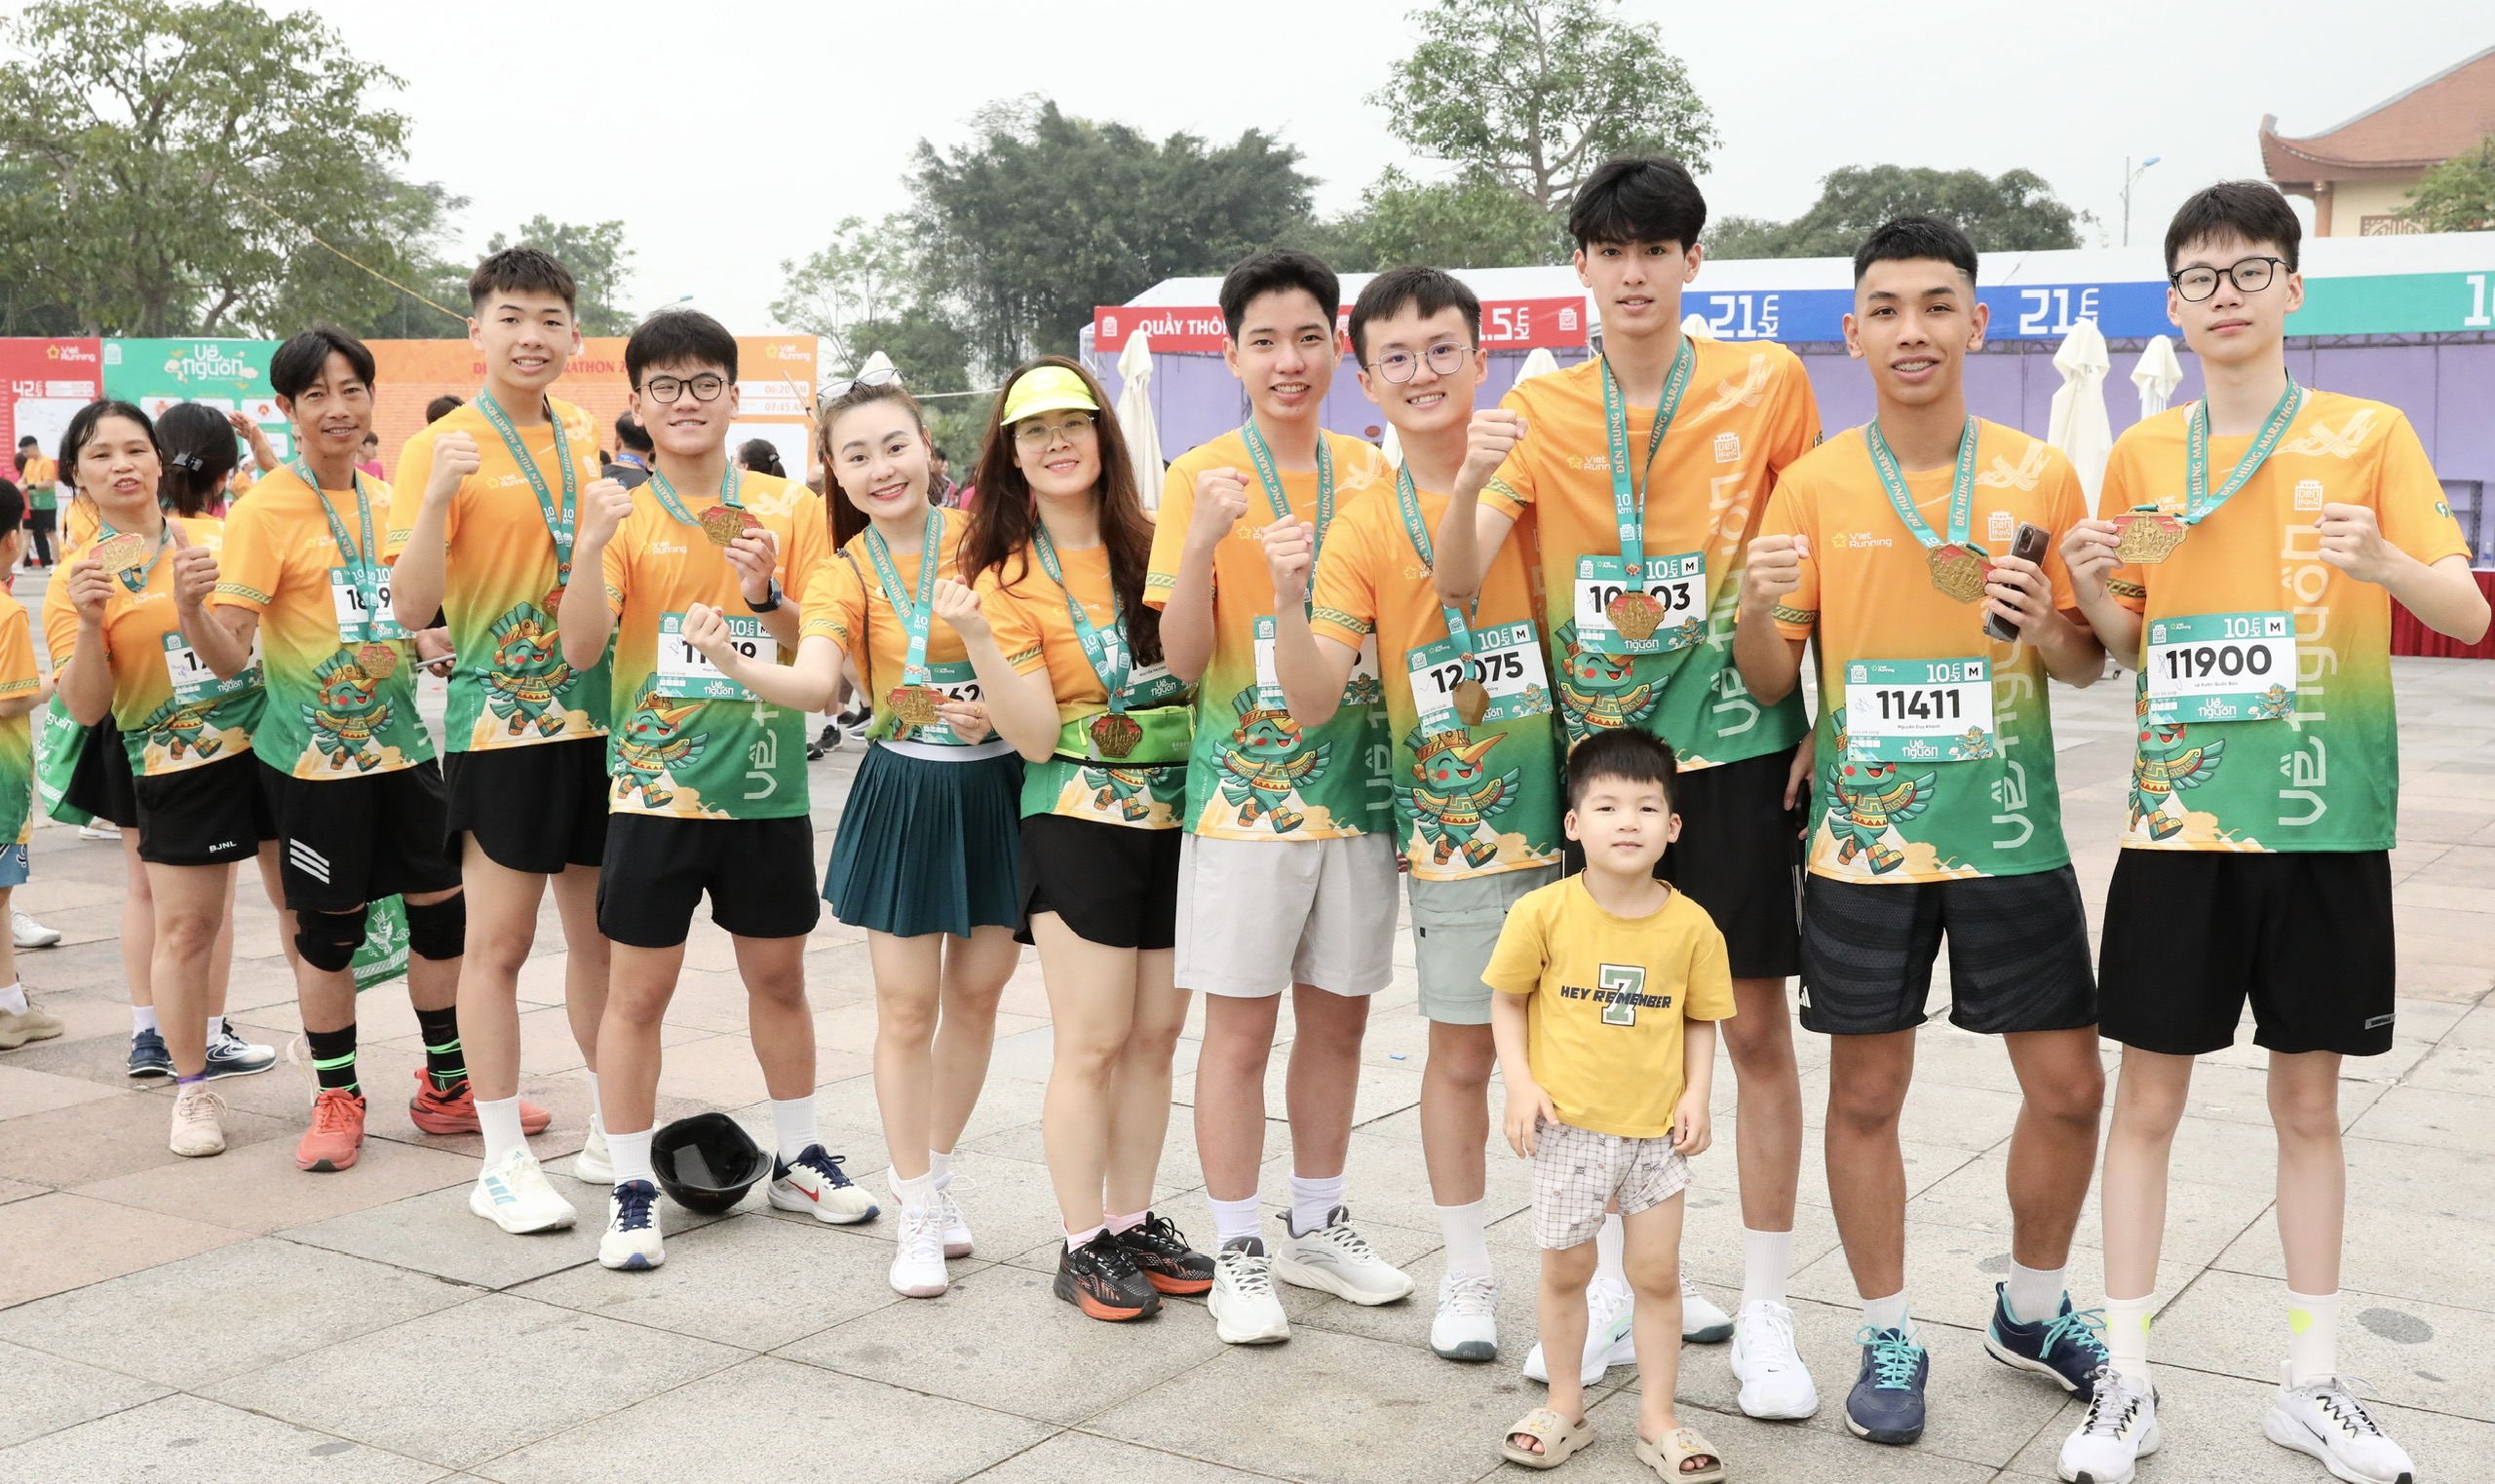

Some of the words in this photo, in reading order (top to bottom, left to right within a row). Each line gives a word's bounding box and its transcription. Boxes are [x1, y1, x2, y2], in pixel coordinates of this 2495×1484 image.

[2464, 274, 2495, 326] 1
[1709, 295, 1757, 338] 21
[2019, 288, 2073, 335] 21
[1138, 312, 1183, 338] QUẦY
[1187, 316, 1228, 335] THÔ
[1478, 308, 1513, 341] .5
[181, 358, 244, 381] nguồn
[563, 362, 615, 374] RATHON
[13, 380, 35, 397] 42
[765, 385, 790, 394] 06:20
[1665, 351, 1690, 415] MARATHON
[765, 402, 789, 411] 07:45
[2258, 395, 2298, 450] MARATHON
[1248, 432, 1276, 483] MARATHON
[1584, 455, 1606, 464] Viet
[1870, 424, 1897, 482] MARATHON
[1616, 494, 1631, 506] 10
[2154, 495, 2176, 504] Viet
[543, 507, 555, 517] 10
[562, 509, 574, 518] 10
[1849, 532, 1872, 541] Viet
[1849, 538, 1892, 549] Running
[652, 545, 687, 554] Running
[352, 569, 365, 580] 10
[1646, 560, 1669, 579] 10
[1685, 562, 1695, 571] M
[1590, 582, 1691, 613] 1003
[729, 620, 748, 636] 10
[914, 614, 929, 626] 10
[2224, 618, 2249, 638] 10
[2270, 623, 2281, 631] M
[1082, 634, 1096, 647] 10
[1478, 630, 1501, 651] 10
[1516, 629, 1526, 639] M
[1625, 639, 1660, 652] nguồn
[2166, 644, 2272, 679] 11900
[1431, 651, 1524, 694] 12075
[1927, 664, 1950, 683] 10
[1969, 667, 1978, 676] M
[704, 686, 734, 697] nguồn
[1151, 683, 1176, 697] nguồn
[1876, 689, 1960, 719] 11411
[2198, 705, 2237, 719] nguồn
[1901, 745, 1938, 759] nguồn
[209, 841, 237, 853] BJNL
[1560, 985, 1592, 1001] HEY
[1592, 989, 1671, 1009] REMEMBER
[1598, 963, 1646, 1027] 7
